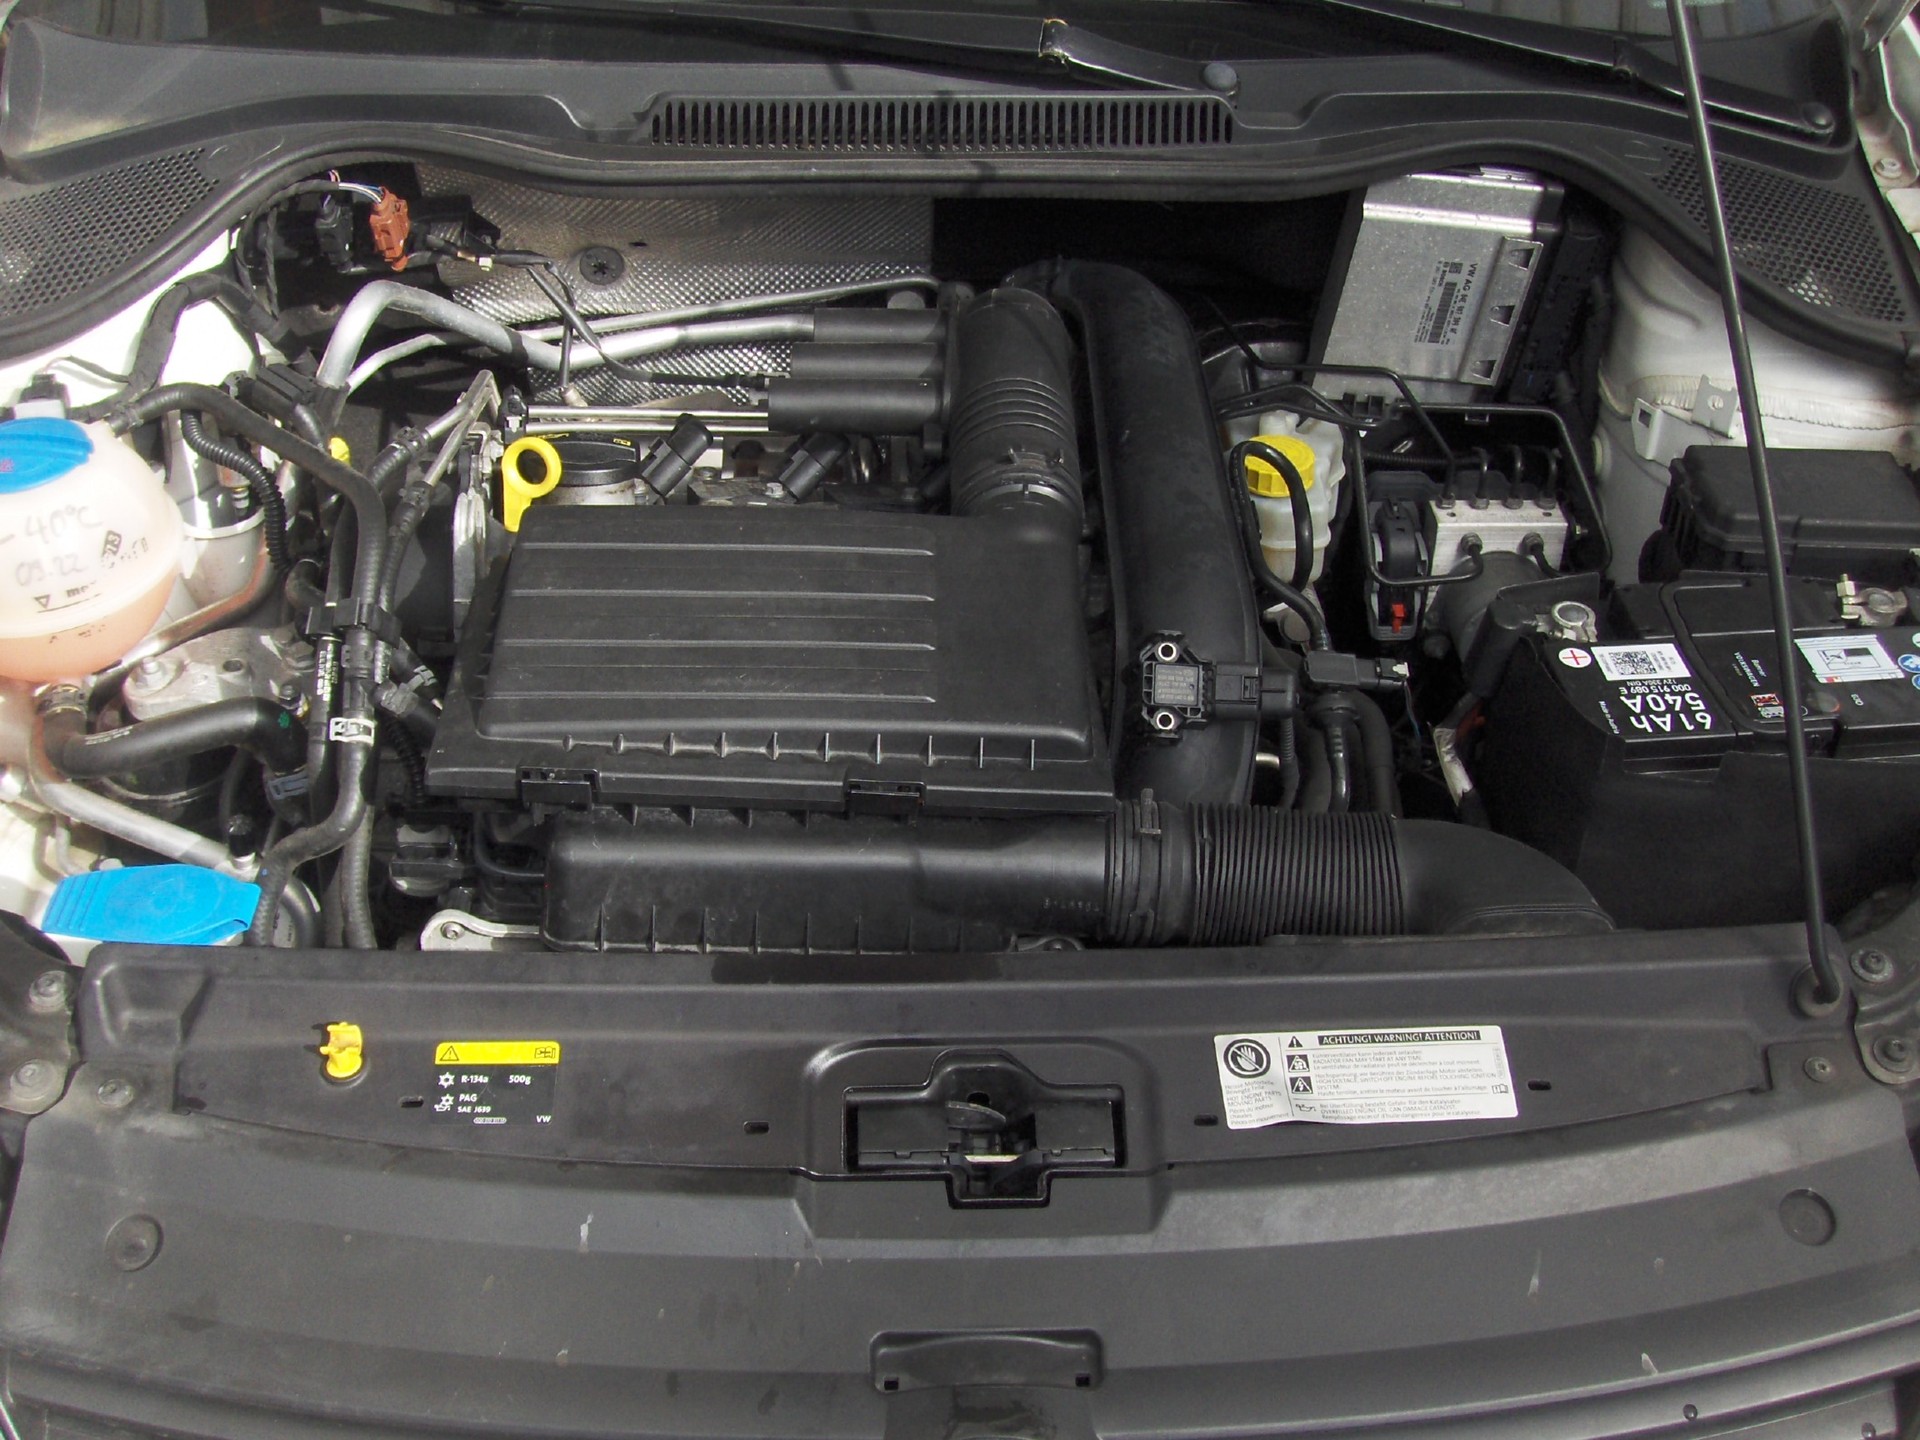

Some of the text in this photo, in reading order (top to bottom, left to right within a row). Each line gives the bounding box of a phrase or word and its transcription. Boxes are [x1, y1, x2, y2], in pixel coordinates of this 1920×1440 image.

[1618, 687, 1628, 695] E
[1650, 685, 1671, 693] 915
[1671, 684, 1692, 692] 000
[1619, 692, 1706, 714] 540A
[1322, 1030, 1478, 1044] ACHTUNG! WARNING! ATTENTION!
[461, 1075, 532, 1085] R-134a 500g
[459, 1094, 478, 1102] PAG
[536, 1115, 552, 1123] VW
